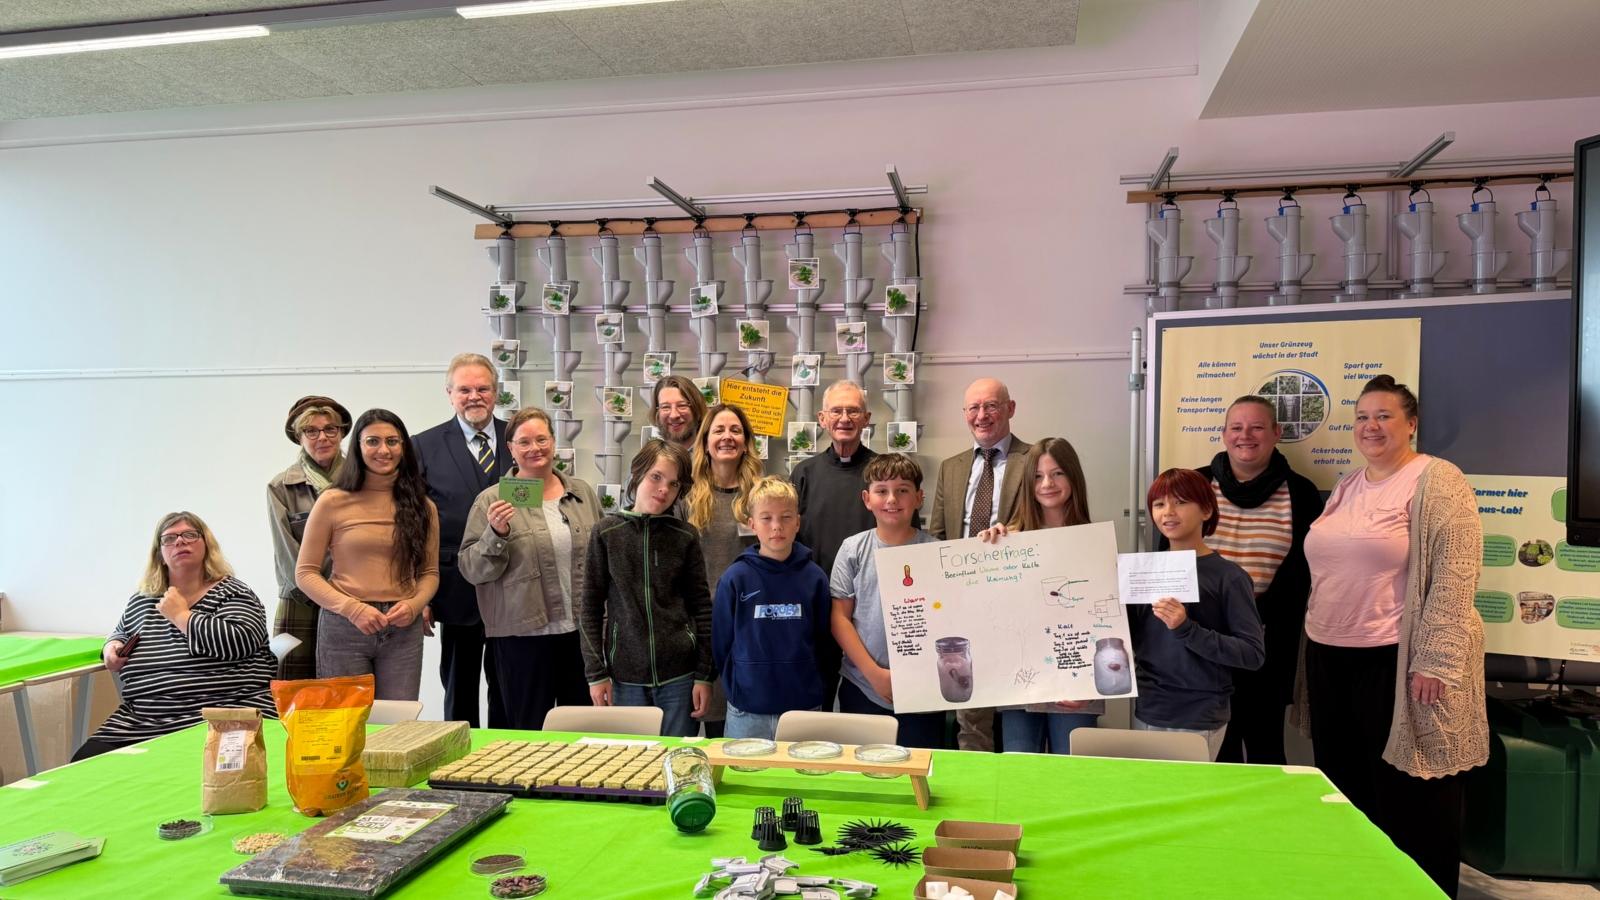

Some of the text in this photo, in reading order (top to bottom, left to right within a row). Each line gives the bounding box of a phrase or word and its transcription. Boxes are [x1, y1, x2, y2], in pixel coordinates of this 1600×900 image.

[1280, 341, 1313, 349] Grünzeug
[1344, 362, 1383, 370] Spart ganz
[1196, 371, 1237, 379] mitmachen!
[742, 386, 770, 394] entsteht
[740, 394, 766, 402] Zukunft
[1199, 395, 1223, 404] langen
[1176, 406, 1226, 414] Transportwege
[1342, 423, 1354, 431] für
[1336, 457, 1351, 465] sich
[1473, 488, 1529, 497] armer hier
[939, 543, 1040, 569] Forscherfrage:
